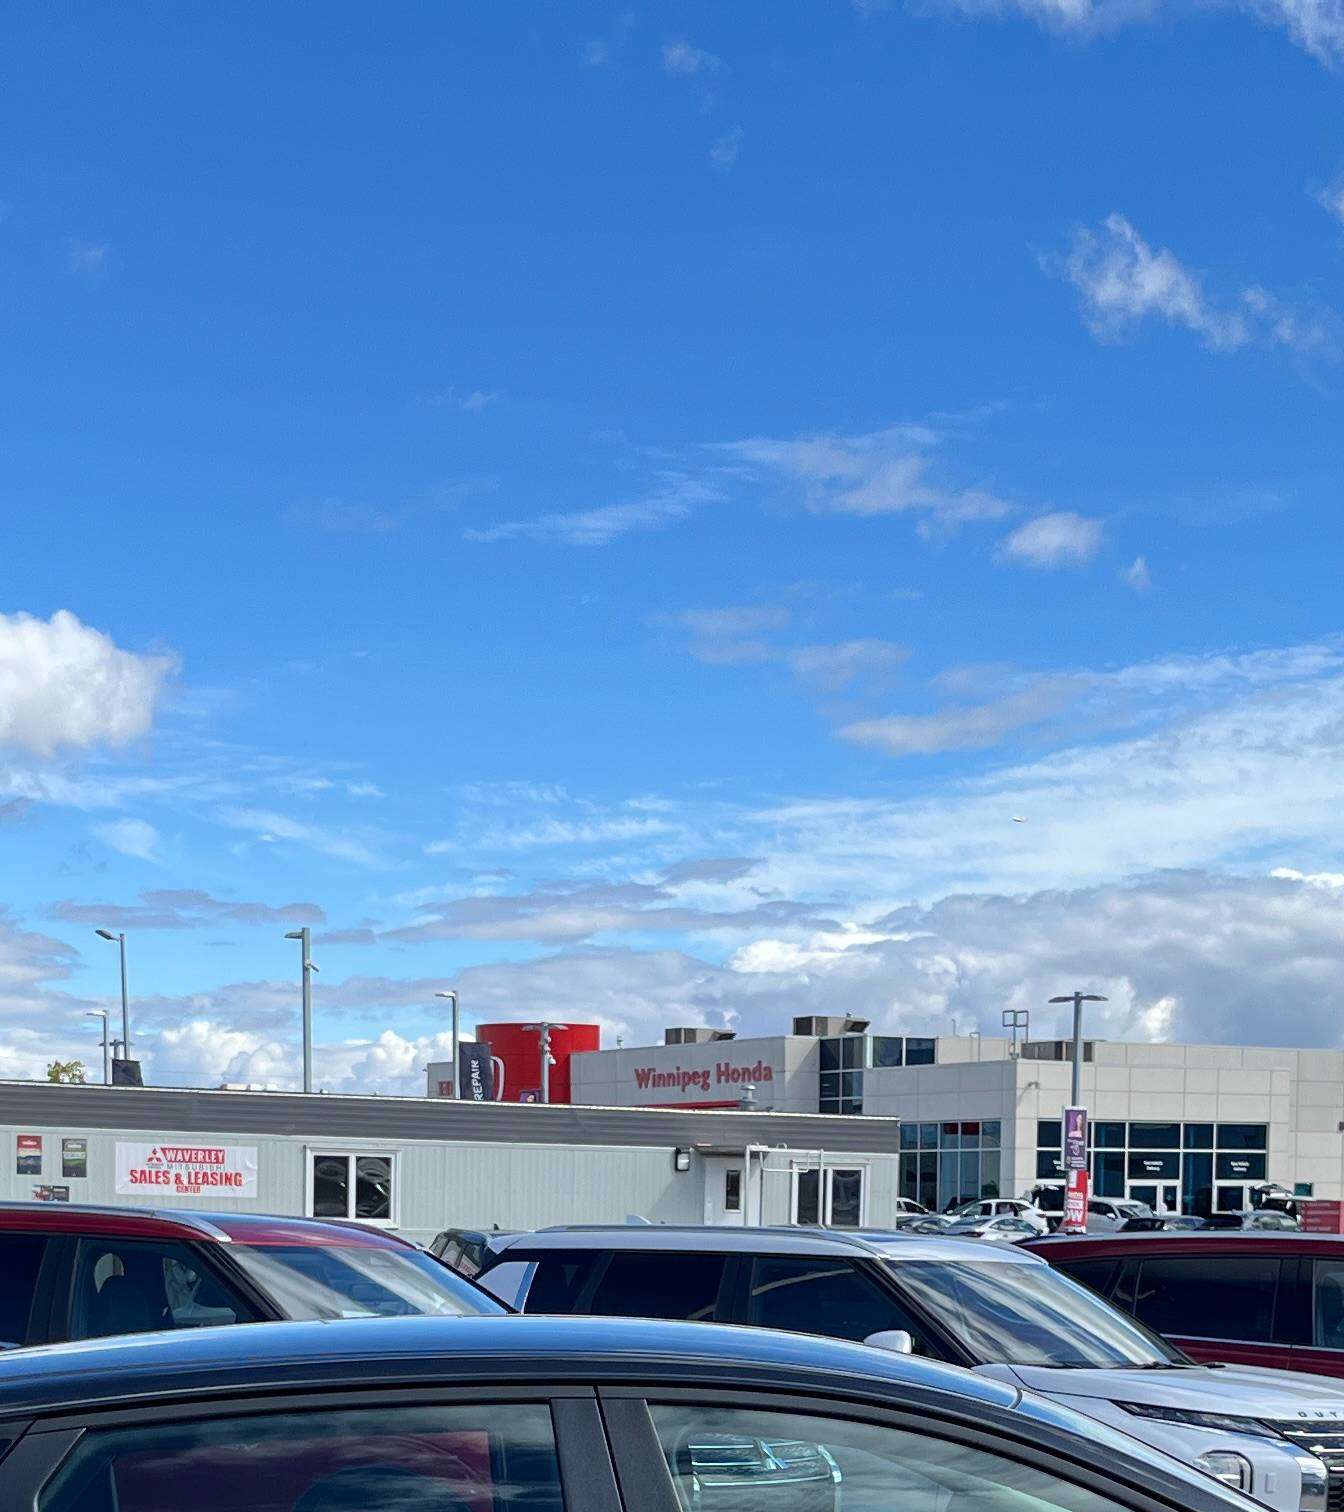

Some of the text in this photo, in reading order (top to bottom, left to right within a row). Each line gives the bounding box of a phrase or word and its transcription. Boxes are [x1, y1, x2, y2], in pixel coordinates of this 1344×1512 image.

[634, 1060, 774, 1093] Winnipeg Honda
[165, 1149, 224, 1163] WAVERLEY
[129, 1169, 242, 1186] SALES & LEASING
